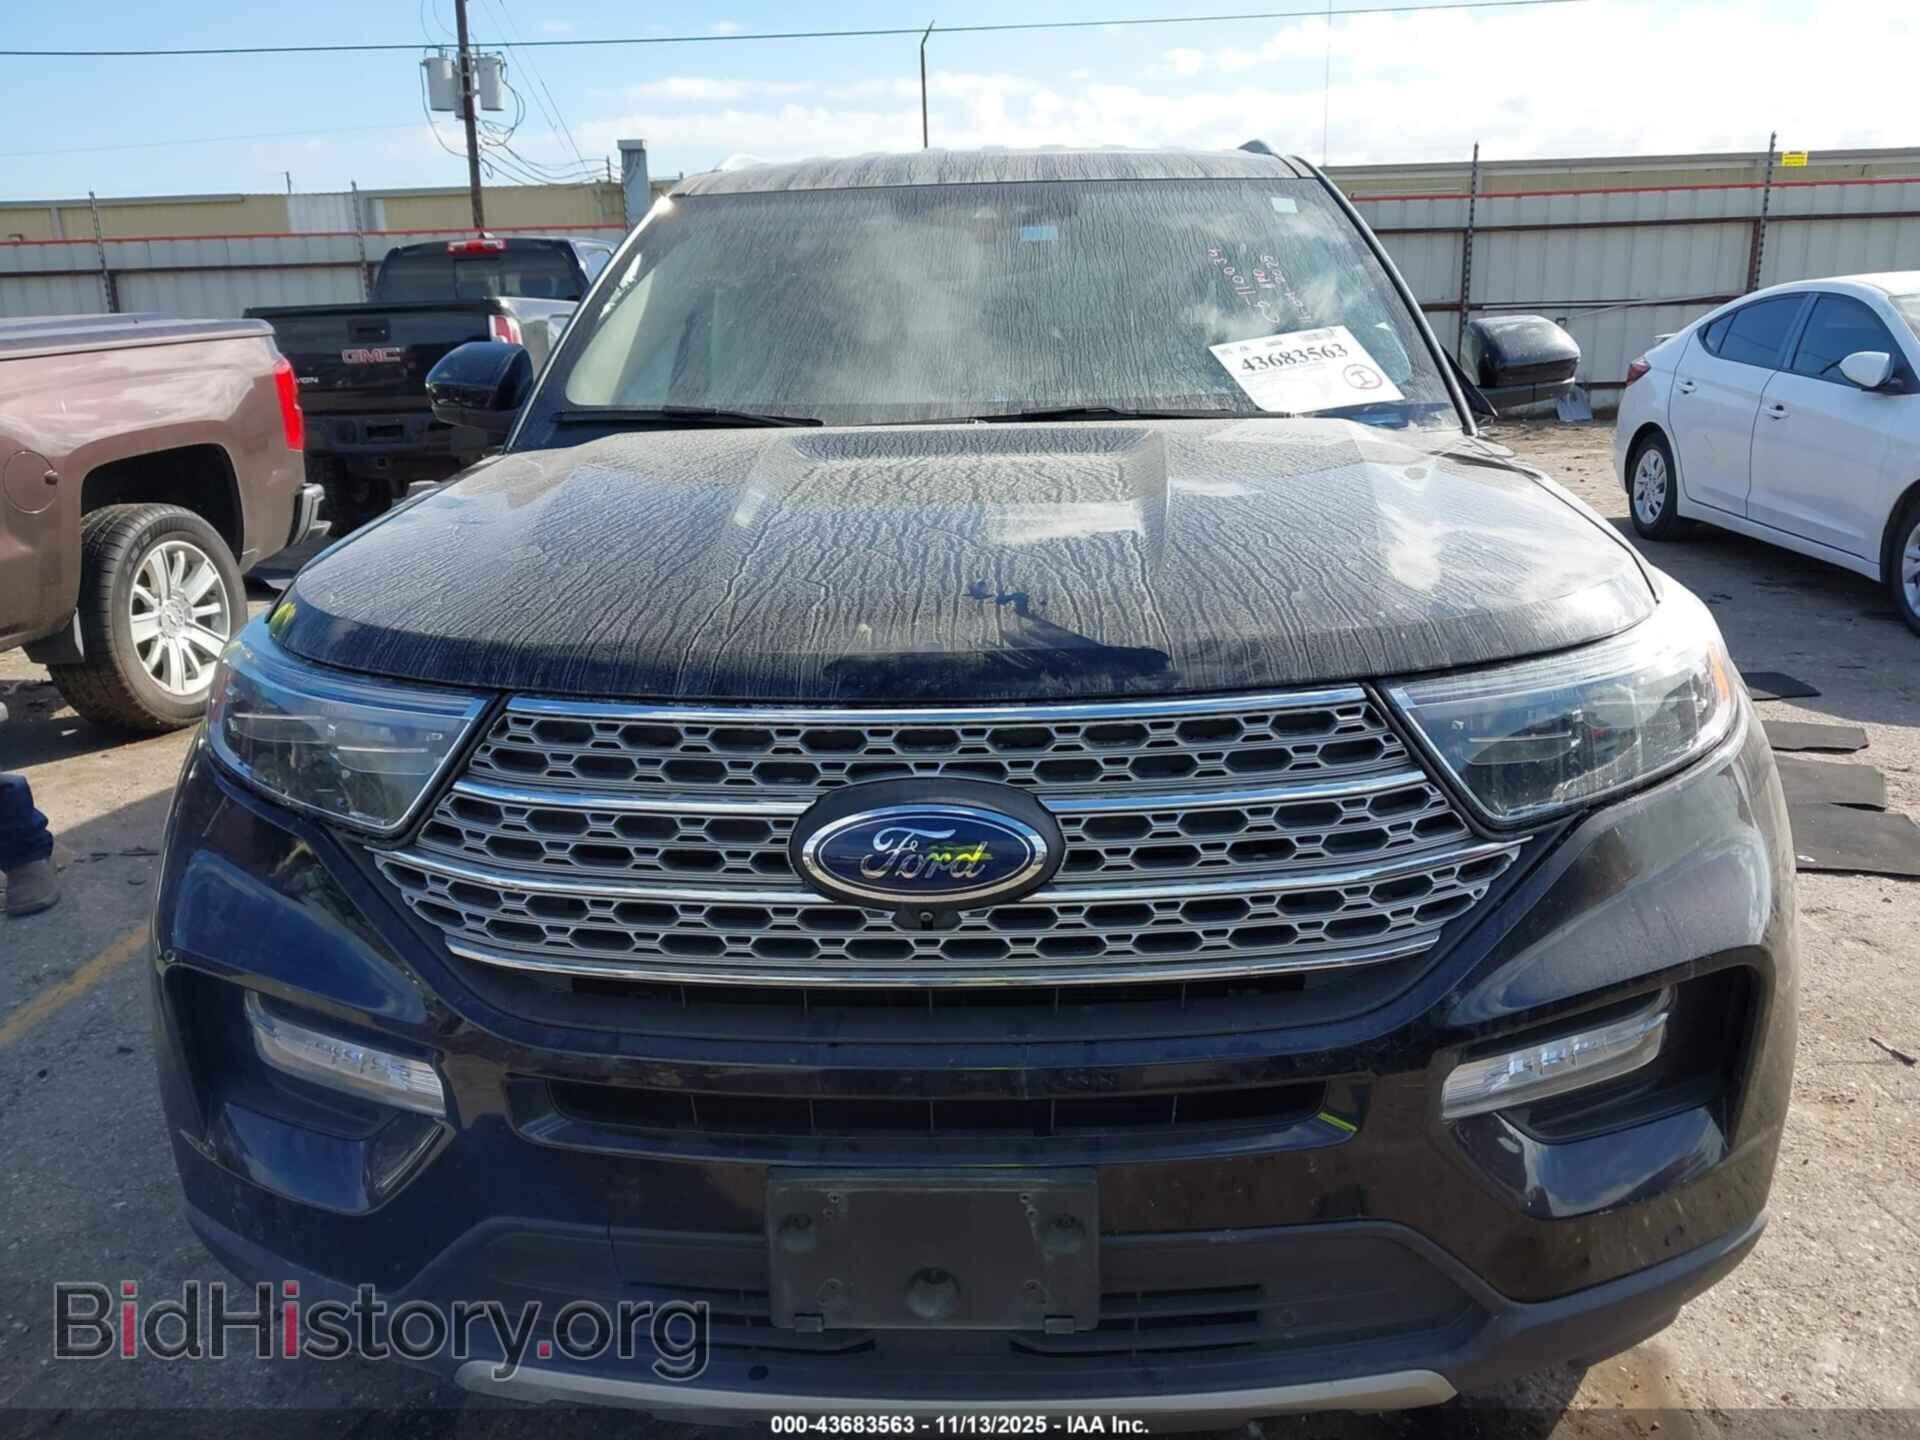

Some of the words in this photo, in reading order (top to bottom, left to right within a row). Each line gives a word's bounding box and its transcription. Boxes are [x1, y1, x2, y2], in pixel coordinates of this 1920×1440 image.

[342, 347, 401, 364] GMC
[1241, 343, 1349, 372] 43683563
[859, 826, 989, 880] Ford
